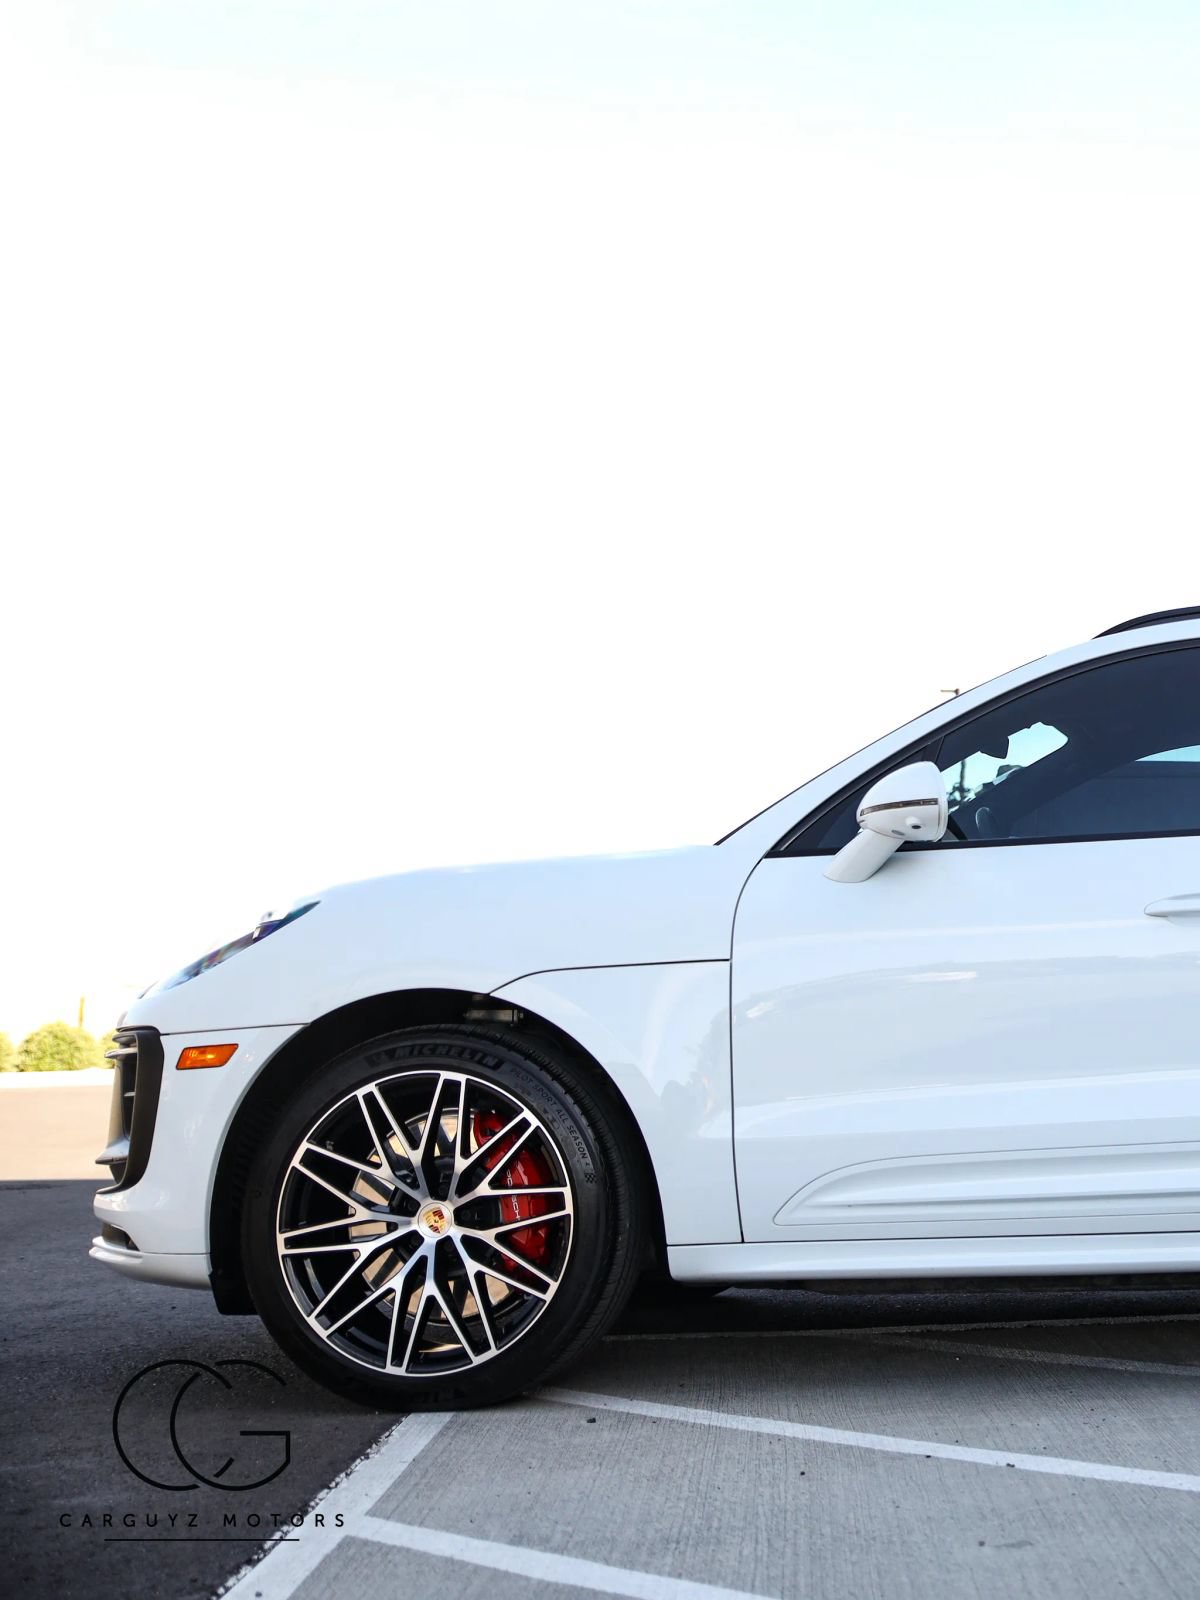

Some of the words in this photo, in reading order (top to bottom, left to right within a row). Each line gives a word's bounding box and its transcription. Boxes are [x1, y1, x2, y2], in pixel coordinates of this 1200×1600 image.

[394, 1044, 499, 1069] MICHELIN
[534, 1085, 557, 1107] SPORT
[556, 1108, 569, 1123] ALL
[566, 1124, 588, 1159] SEASON
